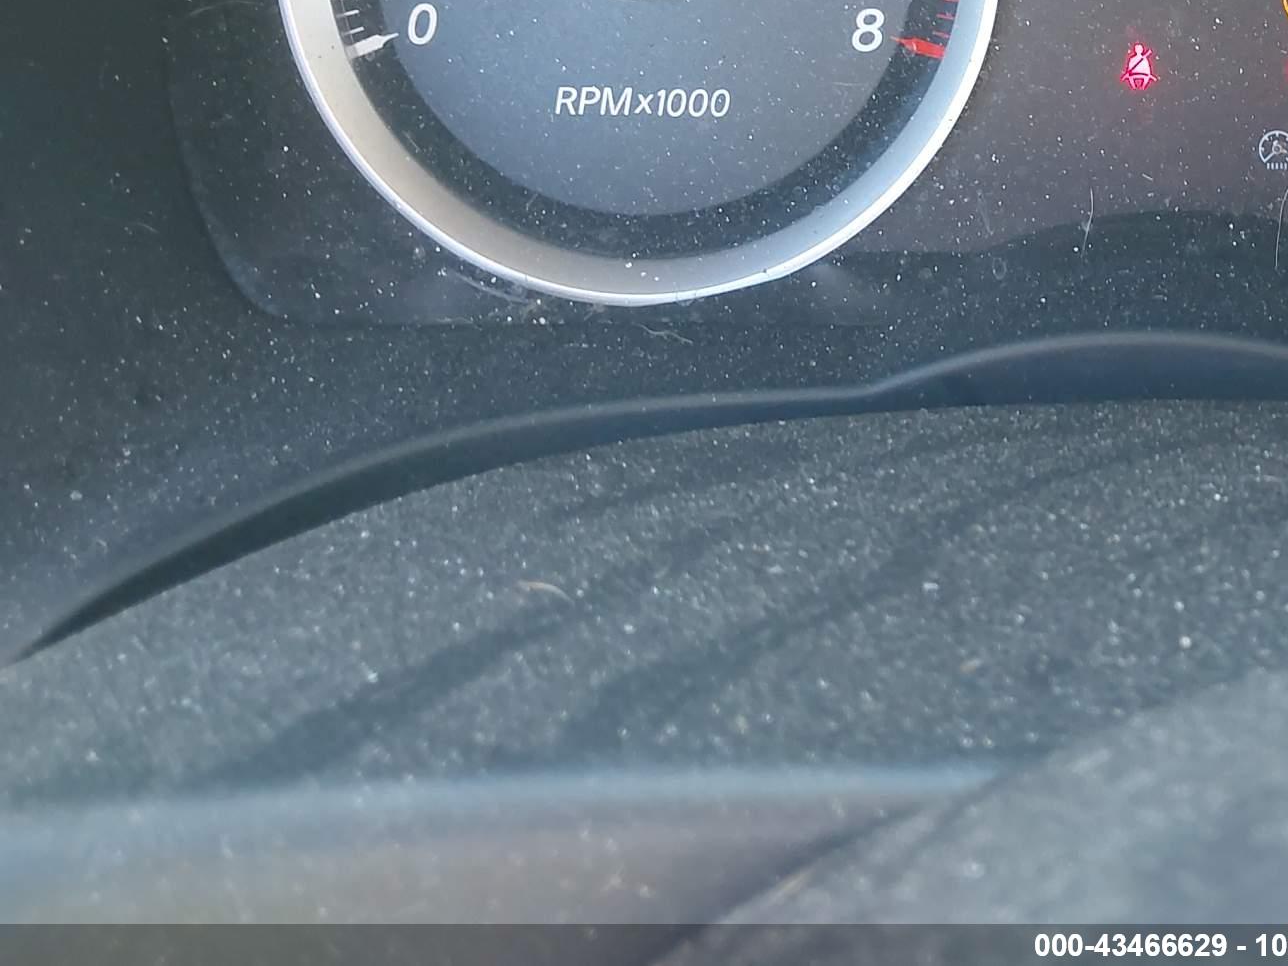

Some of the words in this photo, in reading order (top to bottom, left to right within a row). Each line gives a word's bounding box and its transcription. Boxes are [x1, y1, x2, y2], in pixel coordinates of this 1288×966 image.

[407, 2, 438, 45] 0
[851, 8, 885, 52] 8
[555, 85, 731, 118] RPMx1000
